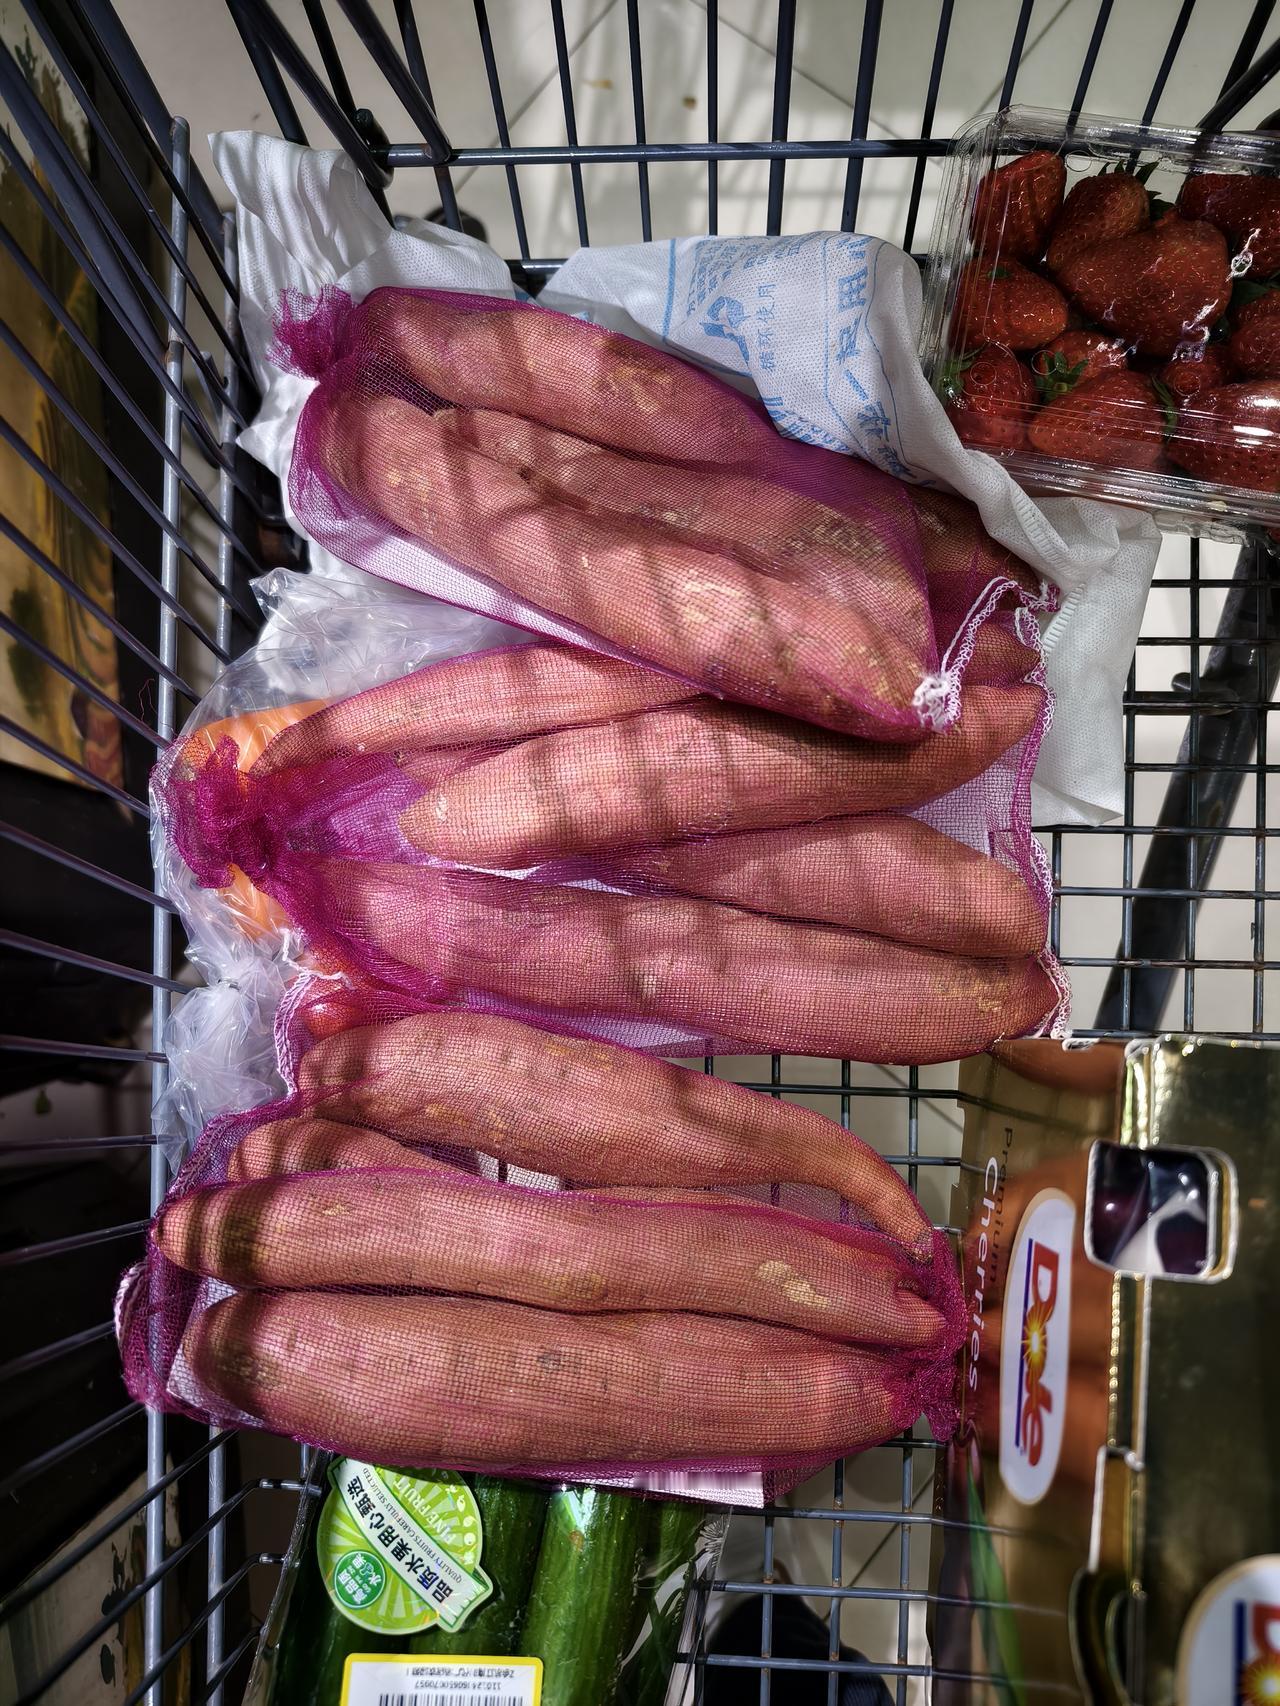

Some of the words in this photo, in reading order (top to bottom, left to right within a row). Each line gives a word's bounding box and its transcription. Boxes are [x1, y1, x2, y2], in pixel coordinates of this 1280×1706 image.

[991, 1127, 1013, 1283] Premium
[969, 1156, 998, 1392] Cherries
[1021, 1241, 1060, 1467] Dole
[393, 1477, 431, 1517] FRUIT
[346, 1475, 454, 1604] 品质水果用心甄选
[385, 1502, 417, 1539] CAREFULLY
[425, 1513, 457, 1546] FINE
[412, 1535, 438, 1562] FRUITS
[337, 1566, 368, 1605] 高品质
[433, 1557, 463, 1585] QUALITY
